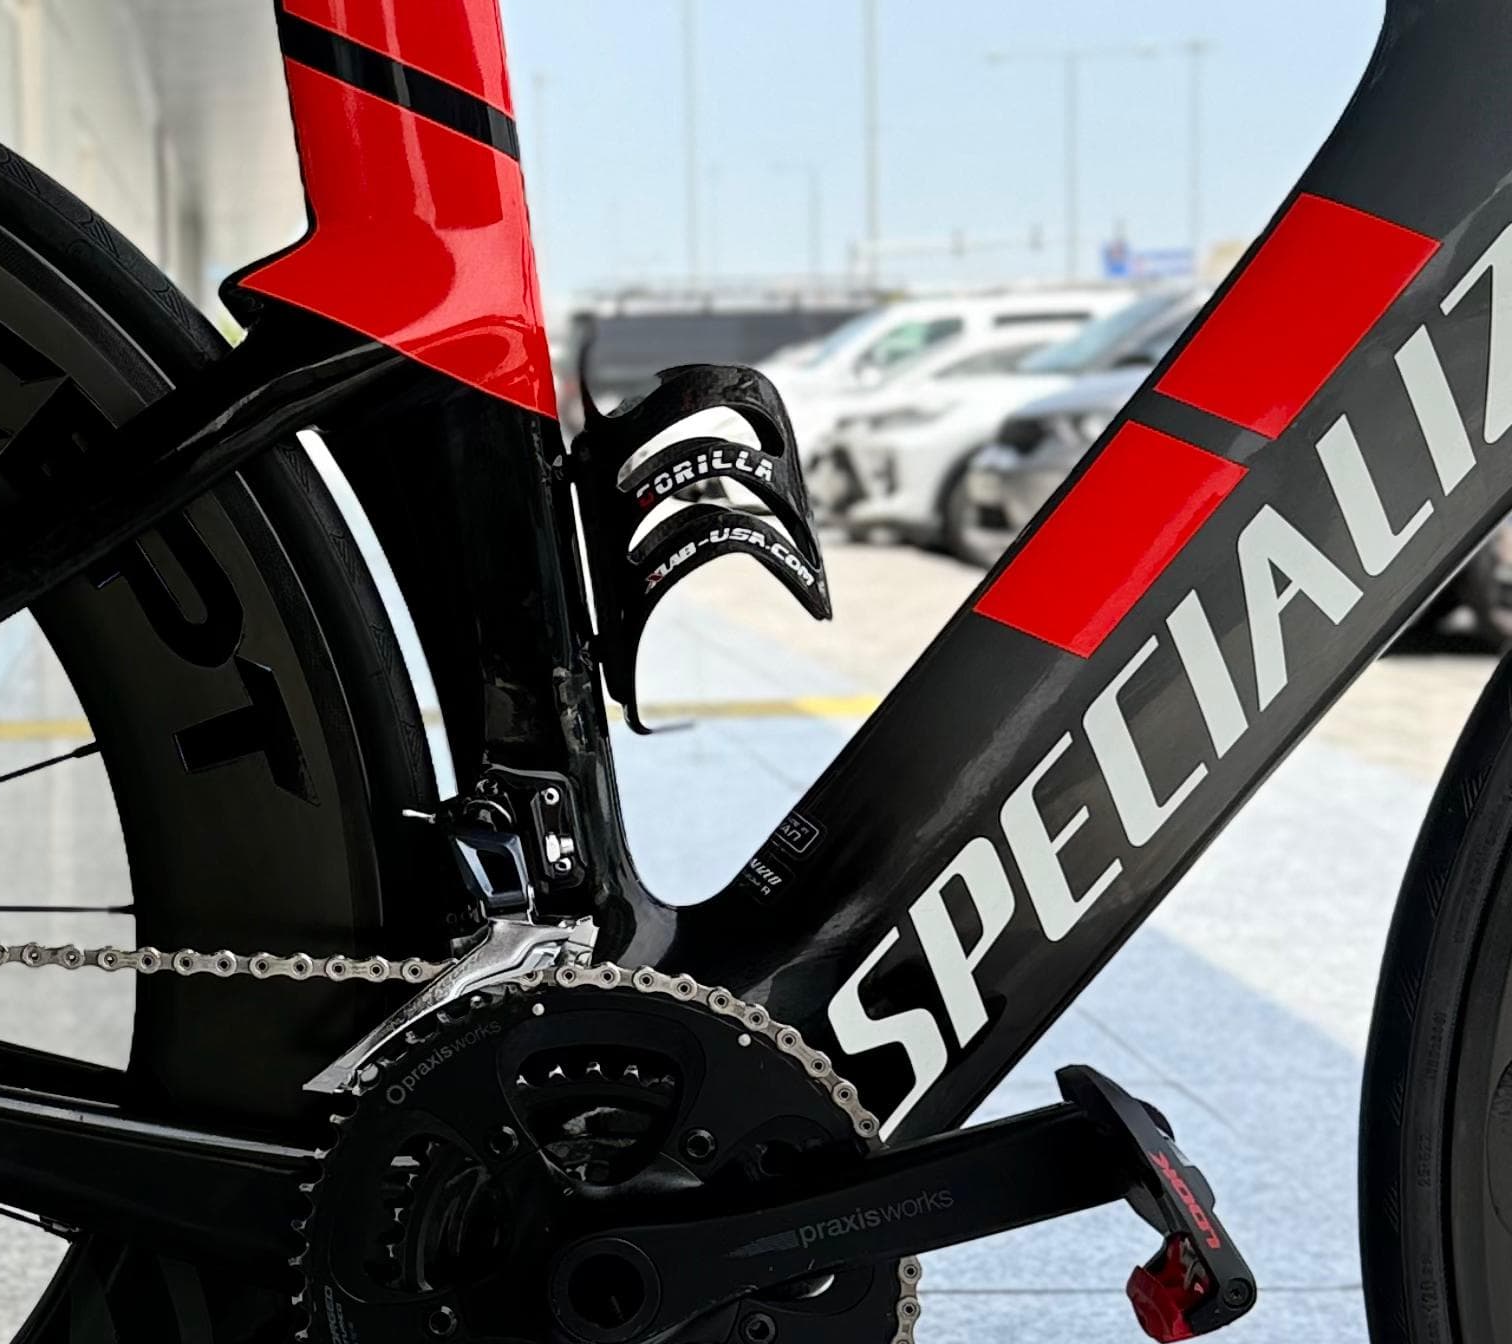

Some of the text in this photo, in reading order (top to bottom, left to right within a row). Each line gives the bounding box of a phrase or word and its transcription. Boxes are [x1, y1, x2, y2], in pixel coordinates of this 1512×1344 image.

[635, 449, 774, 508] GORILLA
[799, 1189, 955, 1248] praxisworks
[1148, 1151, 1222, 1250] LOOK
